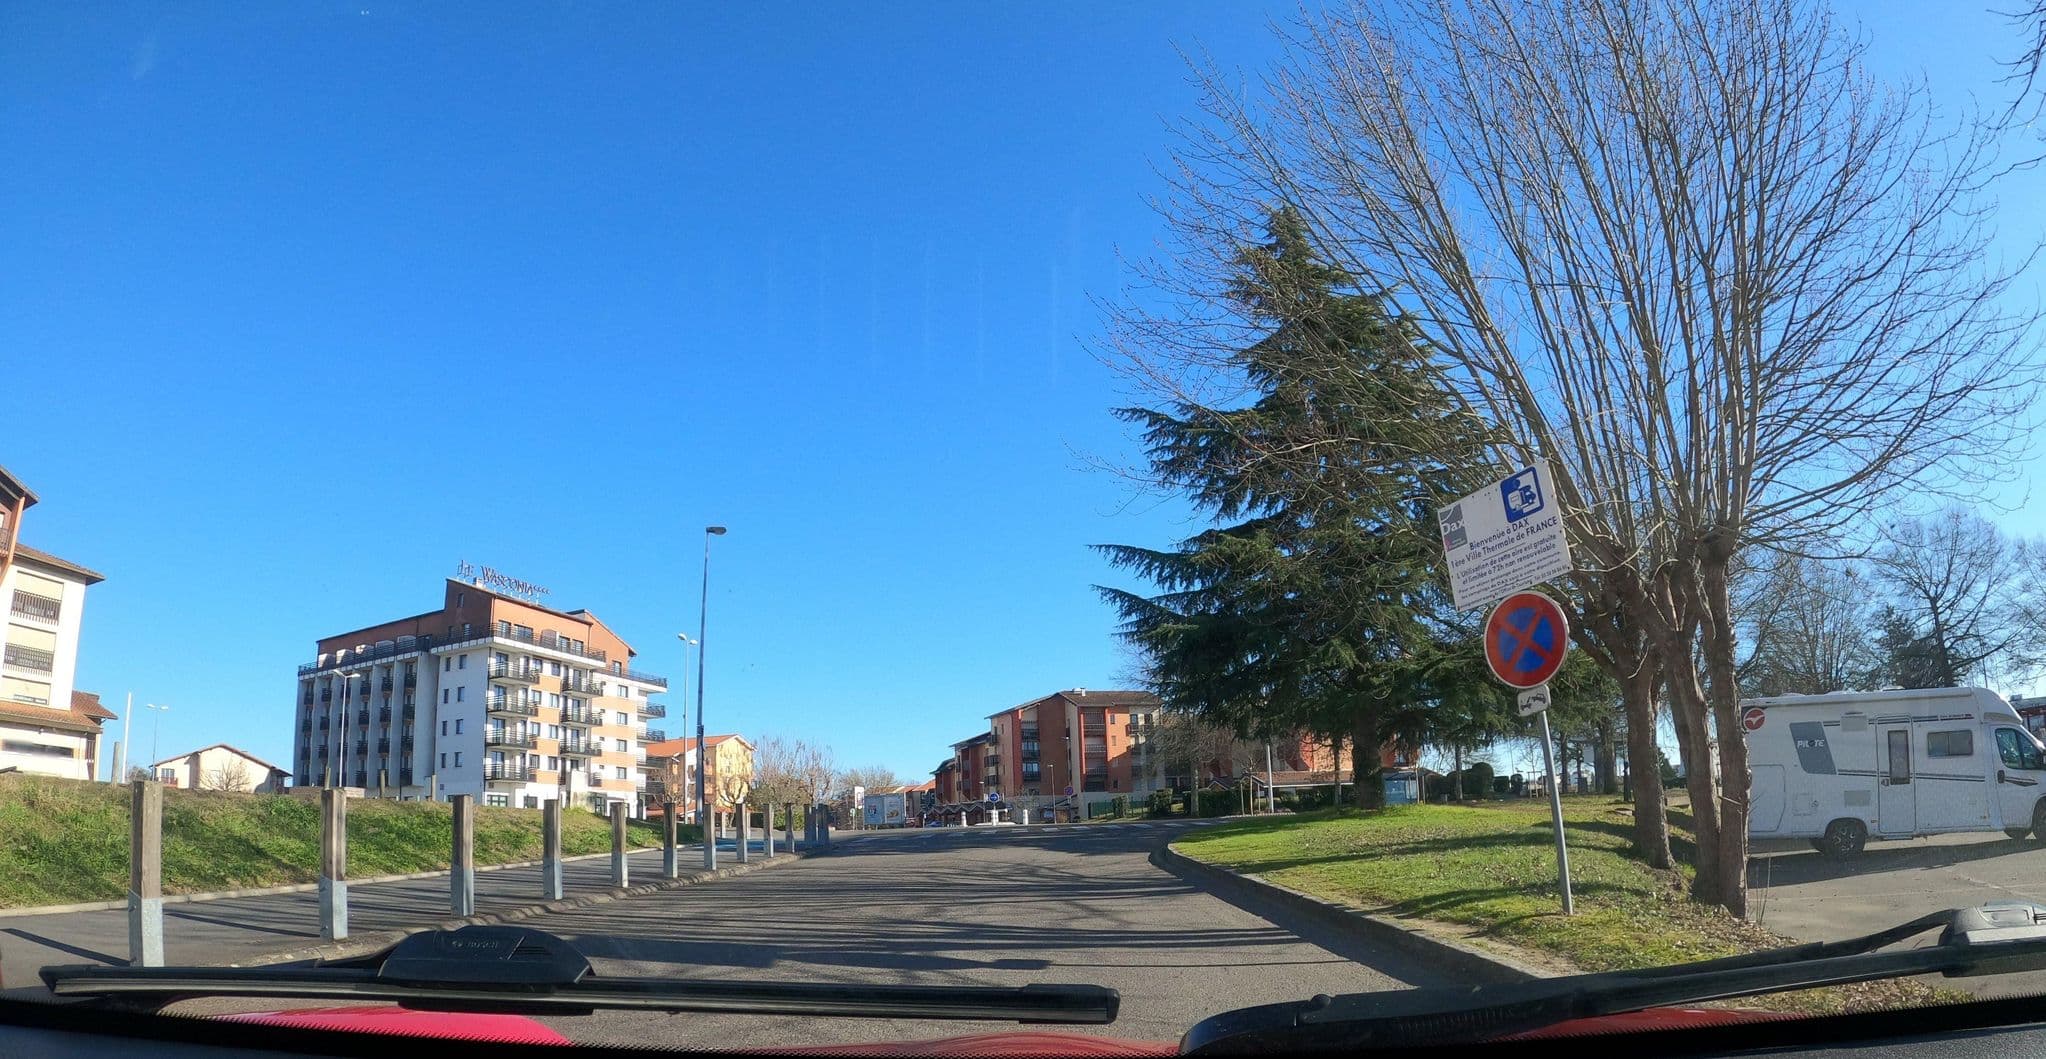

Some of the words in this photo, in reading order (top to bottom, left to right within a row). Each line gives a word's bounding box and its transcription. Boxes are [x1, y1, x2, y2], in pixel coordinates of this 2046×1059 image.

[1441, 519, 1464, 536] Dax
[1465, 548, 1481, 562] Ville
[1482, 534, 1514, 555] Thermale
[1525, 515, 1557, 536] FRANCE
[1469, 528, 1505, 550] Bienvenue
[1512, 517, 1529, 532] DAX
[1492, 562, 1504, 573] 72h
[1504, 559, 1515, 568] non
[1516, 541, 1555, 562] renouvelable
[1497, 552, 1510, 562] cette
[1511, 546, 1523, 556] aire
[1523, 542, 1532, 551] est
[1533, 533, 1556, 548] gratuite
